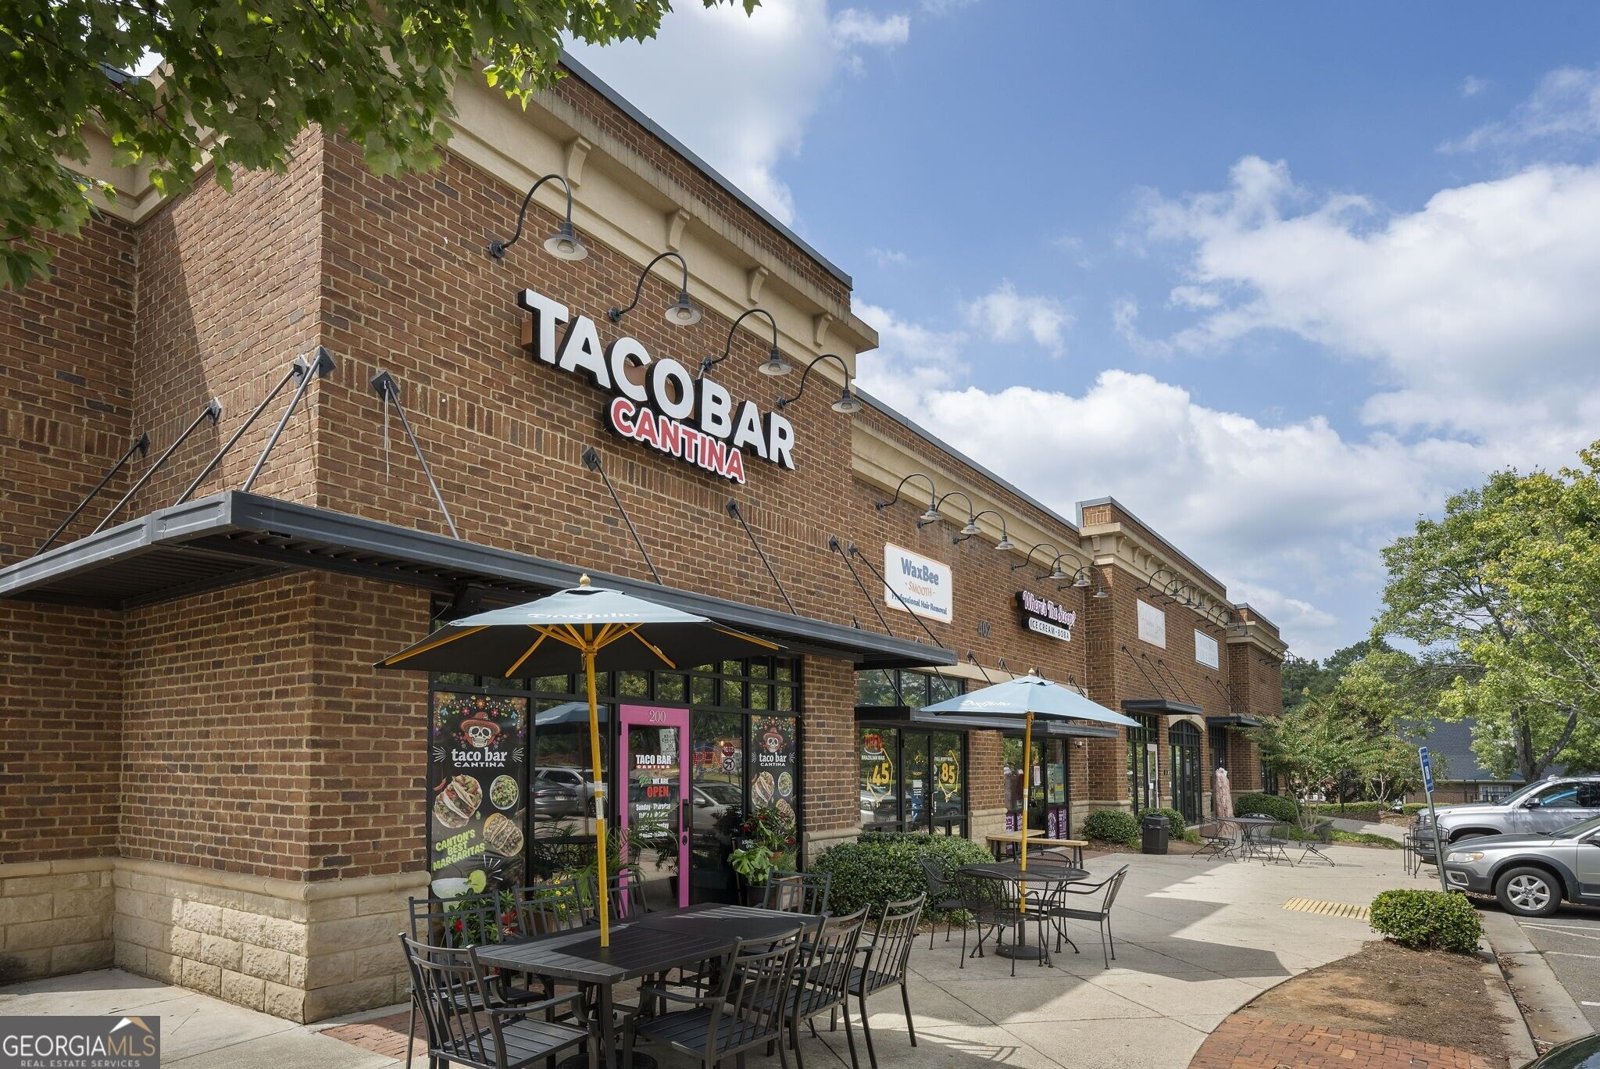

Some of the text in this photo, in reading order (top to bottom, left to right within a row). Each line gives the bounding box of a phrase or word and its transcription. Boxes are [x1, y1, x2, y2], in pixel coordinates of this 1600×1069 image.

[610, 396, 746, 485] CANTINA
[901, 557, 939, 586] WaxBee
[908, 581, 932, 597] SMOOTH
[921, 600, 930, 610] Hair
[930, 603, 947, 615] Removal
[1030, 619, 1039, 630] ICE
[1039, 622, 1056, 635] CREAM
[649, 709, 667, 722] 200
[451, 747, 508, 762] taco bar
[636, 754, 672, 765] TACO BAR
[759, 752, 787, 763] taco bar
[872, 762, 889, 785] 45
[941, 762, 955, 784] 85
[646, 785, 670, 798] OPEN
[435, 829, 476, 851] CANTON'S
[447, 840, 468, 856] BEST
[432, 842, 486, 871] MARGARITAS
